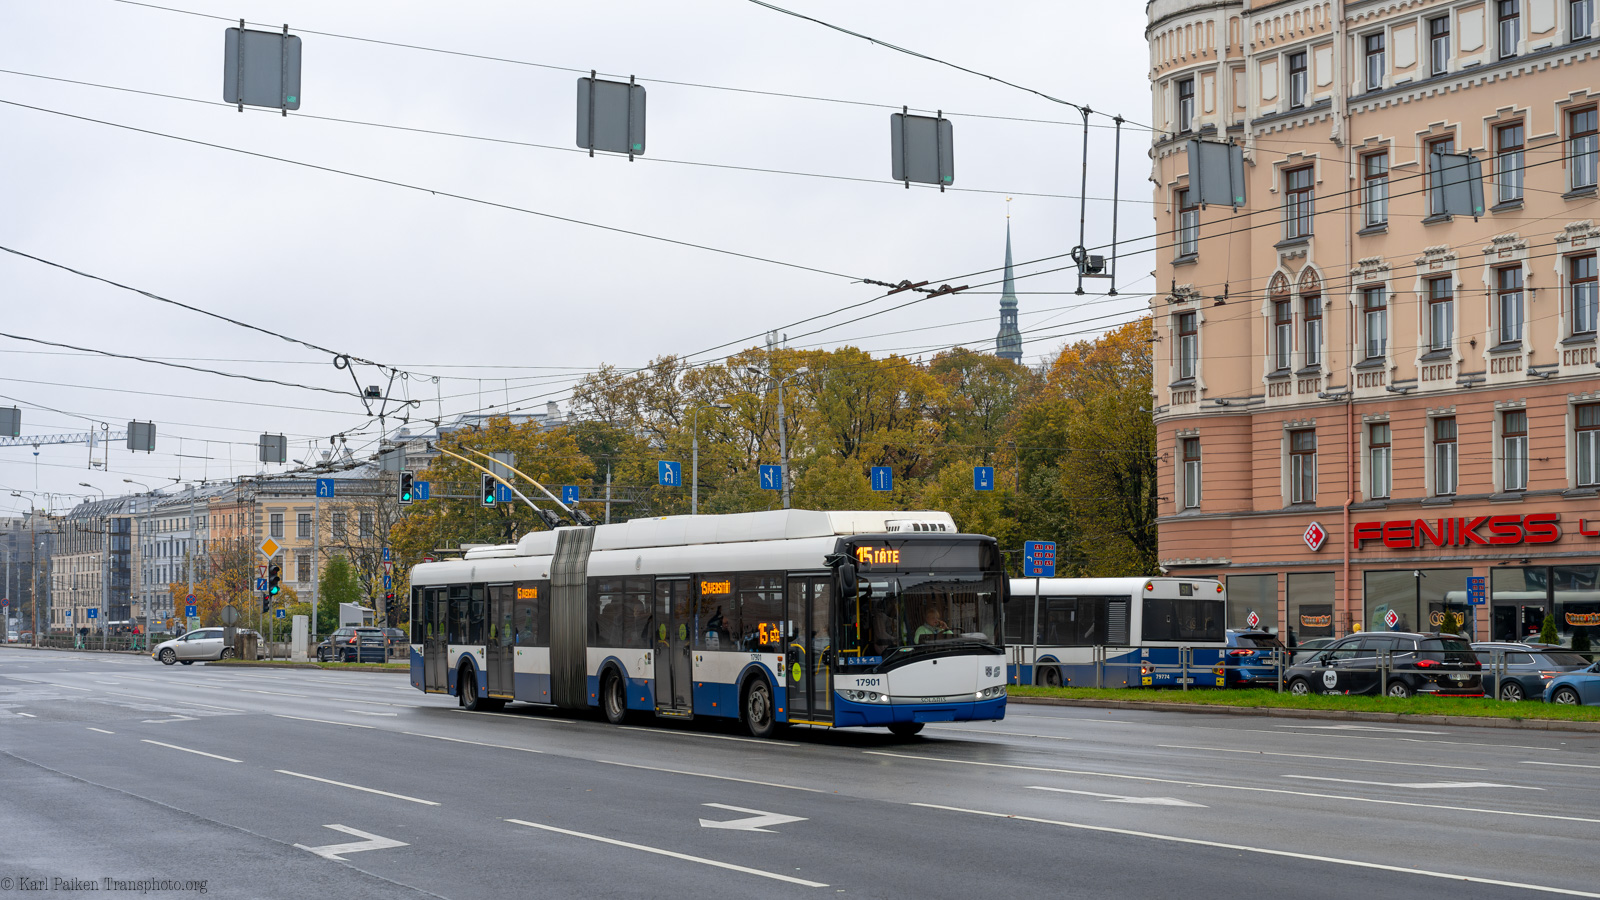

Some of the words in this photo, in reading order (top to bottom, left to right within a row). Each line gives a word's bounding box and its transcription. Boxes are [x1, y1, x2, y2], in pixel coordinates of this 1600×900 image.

[1354, 513, 1559, 549] FENIKSS
[856, 547, 873, 564] 15
[874, 548, 899, 563] TĀTE
[751, 653, 761, 661] 17901
[855, 678, 880, 686] 17901
